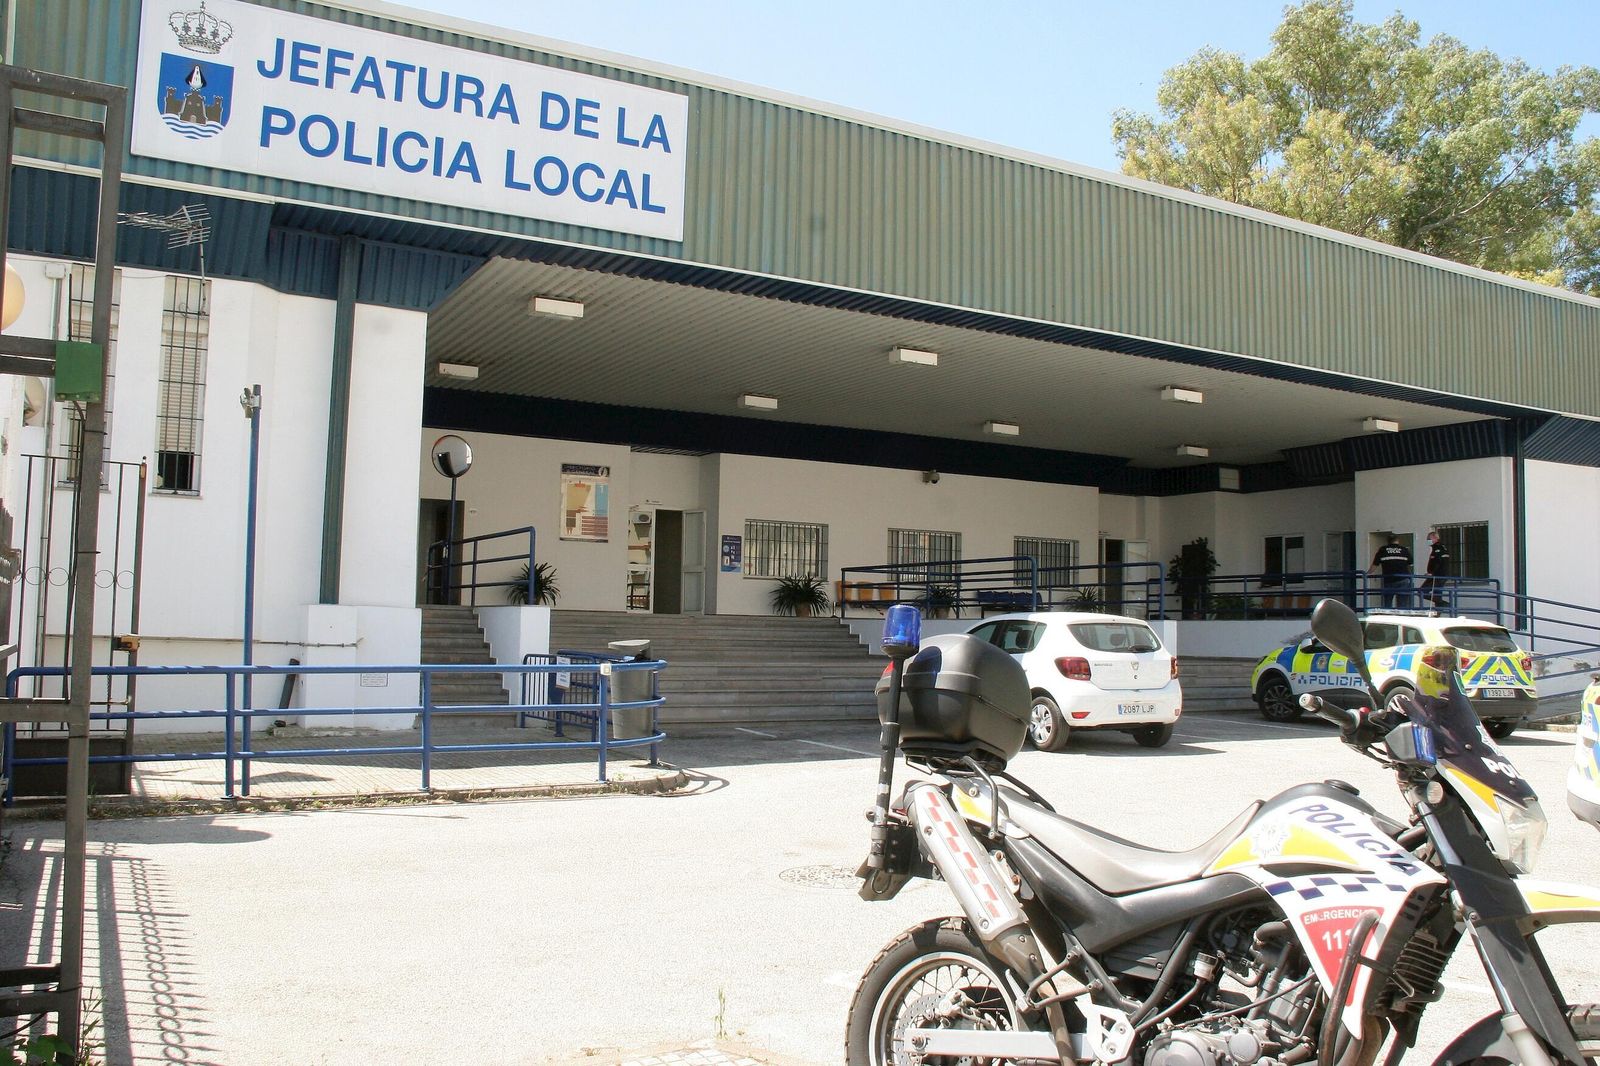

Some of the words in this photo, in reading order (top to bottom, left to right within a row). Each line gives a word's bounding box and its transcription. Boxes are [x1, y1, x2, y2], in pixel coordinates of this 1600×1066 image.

[256, 37, 519, 124] JEFATURA
[540, 91, 600, 138] DE
[616, 107, 671, 153] LA
[260, 105, 481, 183] POLICIA
[505, 149, 666, 214] LOCAL
[1123, 705, 1140, 713] 2087
[1141, 704, 1154, 713] LJP
[1309, 675, 1363, 687] POLICIA
[1287, 803, 1422, 877] POLICIA
